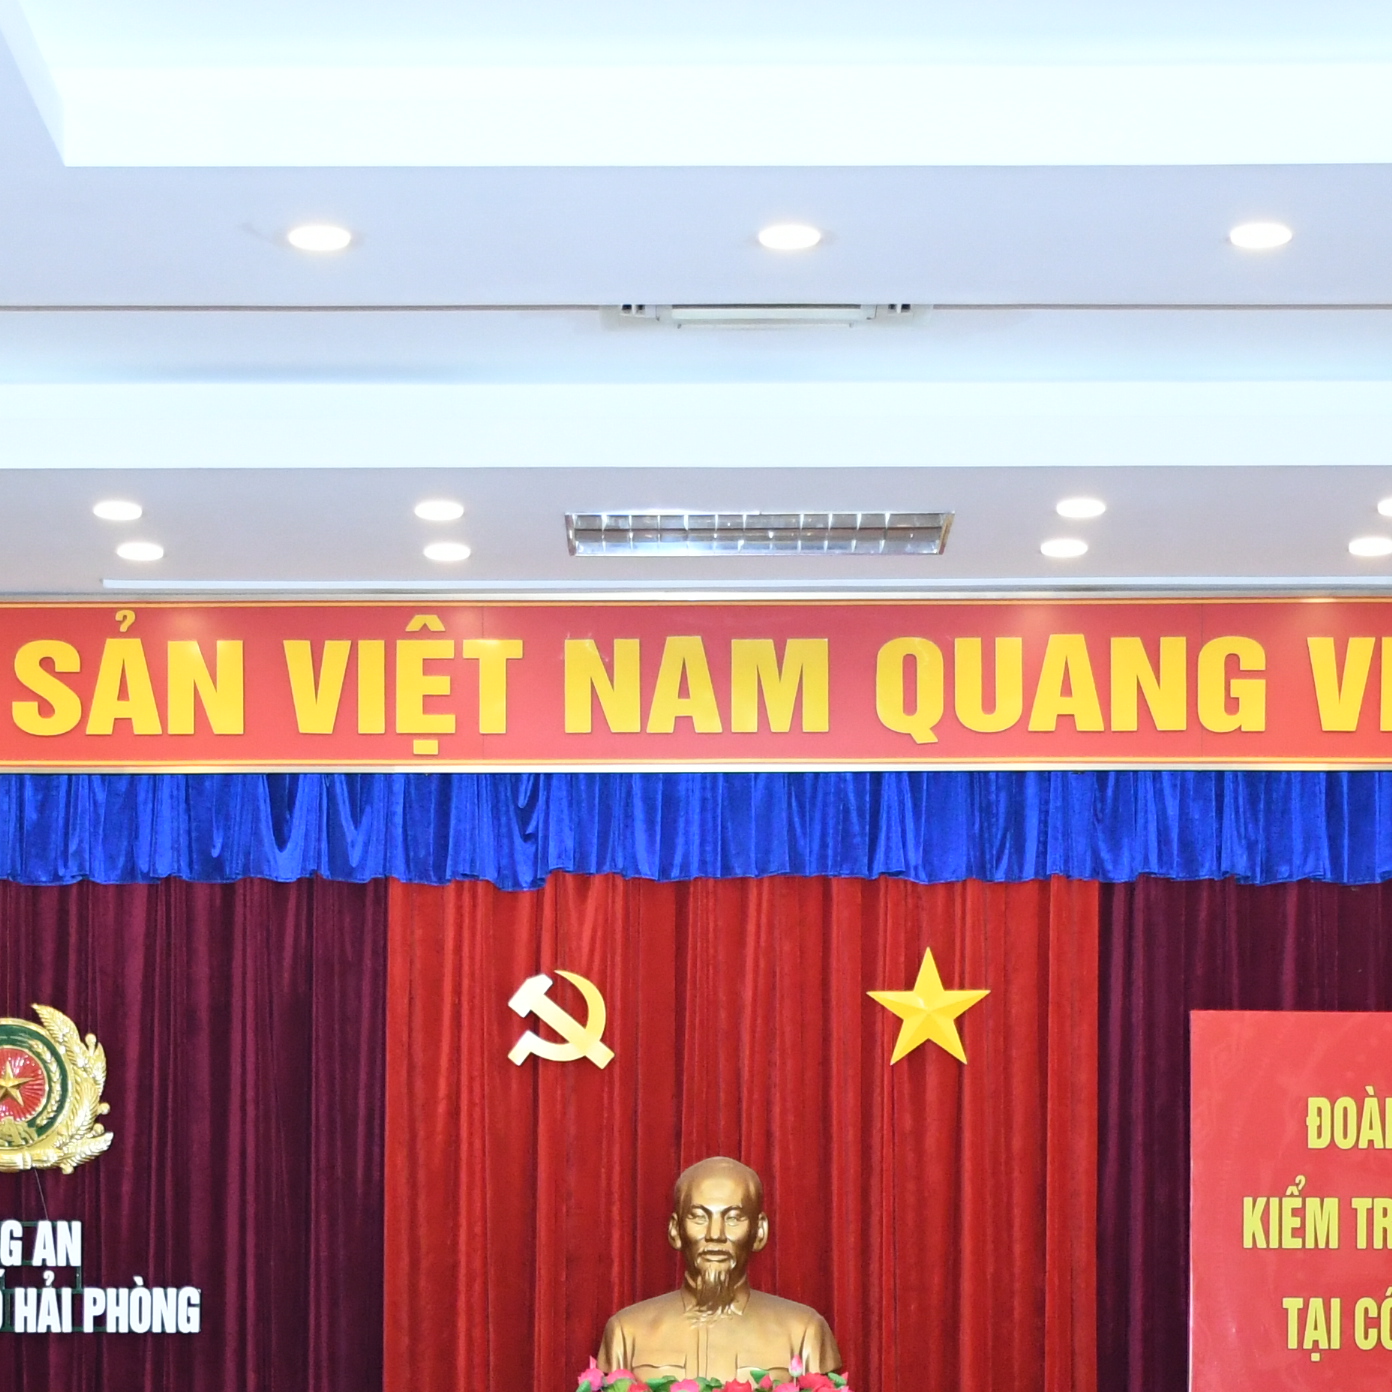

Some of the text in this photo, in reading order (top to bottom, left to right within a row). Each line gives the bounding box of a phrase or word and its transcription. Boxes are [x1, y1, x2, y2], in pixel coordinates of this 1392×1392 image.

[12, 610, 244, 735] SẢN
[284, 615, 523, 754] VIỆT
[565, 637, 829, 733] NAM
[877, 634, 1266, 743] QUANG
[1243, 1175, 1338, 1248] KIỂM
[32, 1221, 81, 1266] AN
[15, 1271, 72, 1332] HẢI
[84, 1277, 200, 1333] PHÒNG
[1283, 1298, 1340, 1361] TẠI
